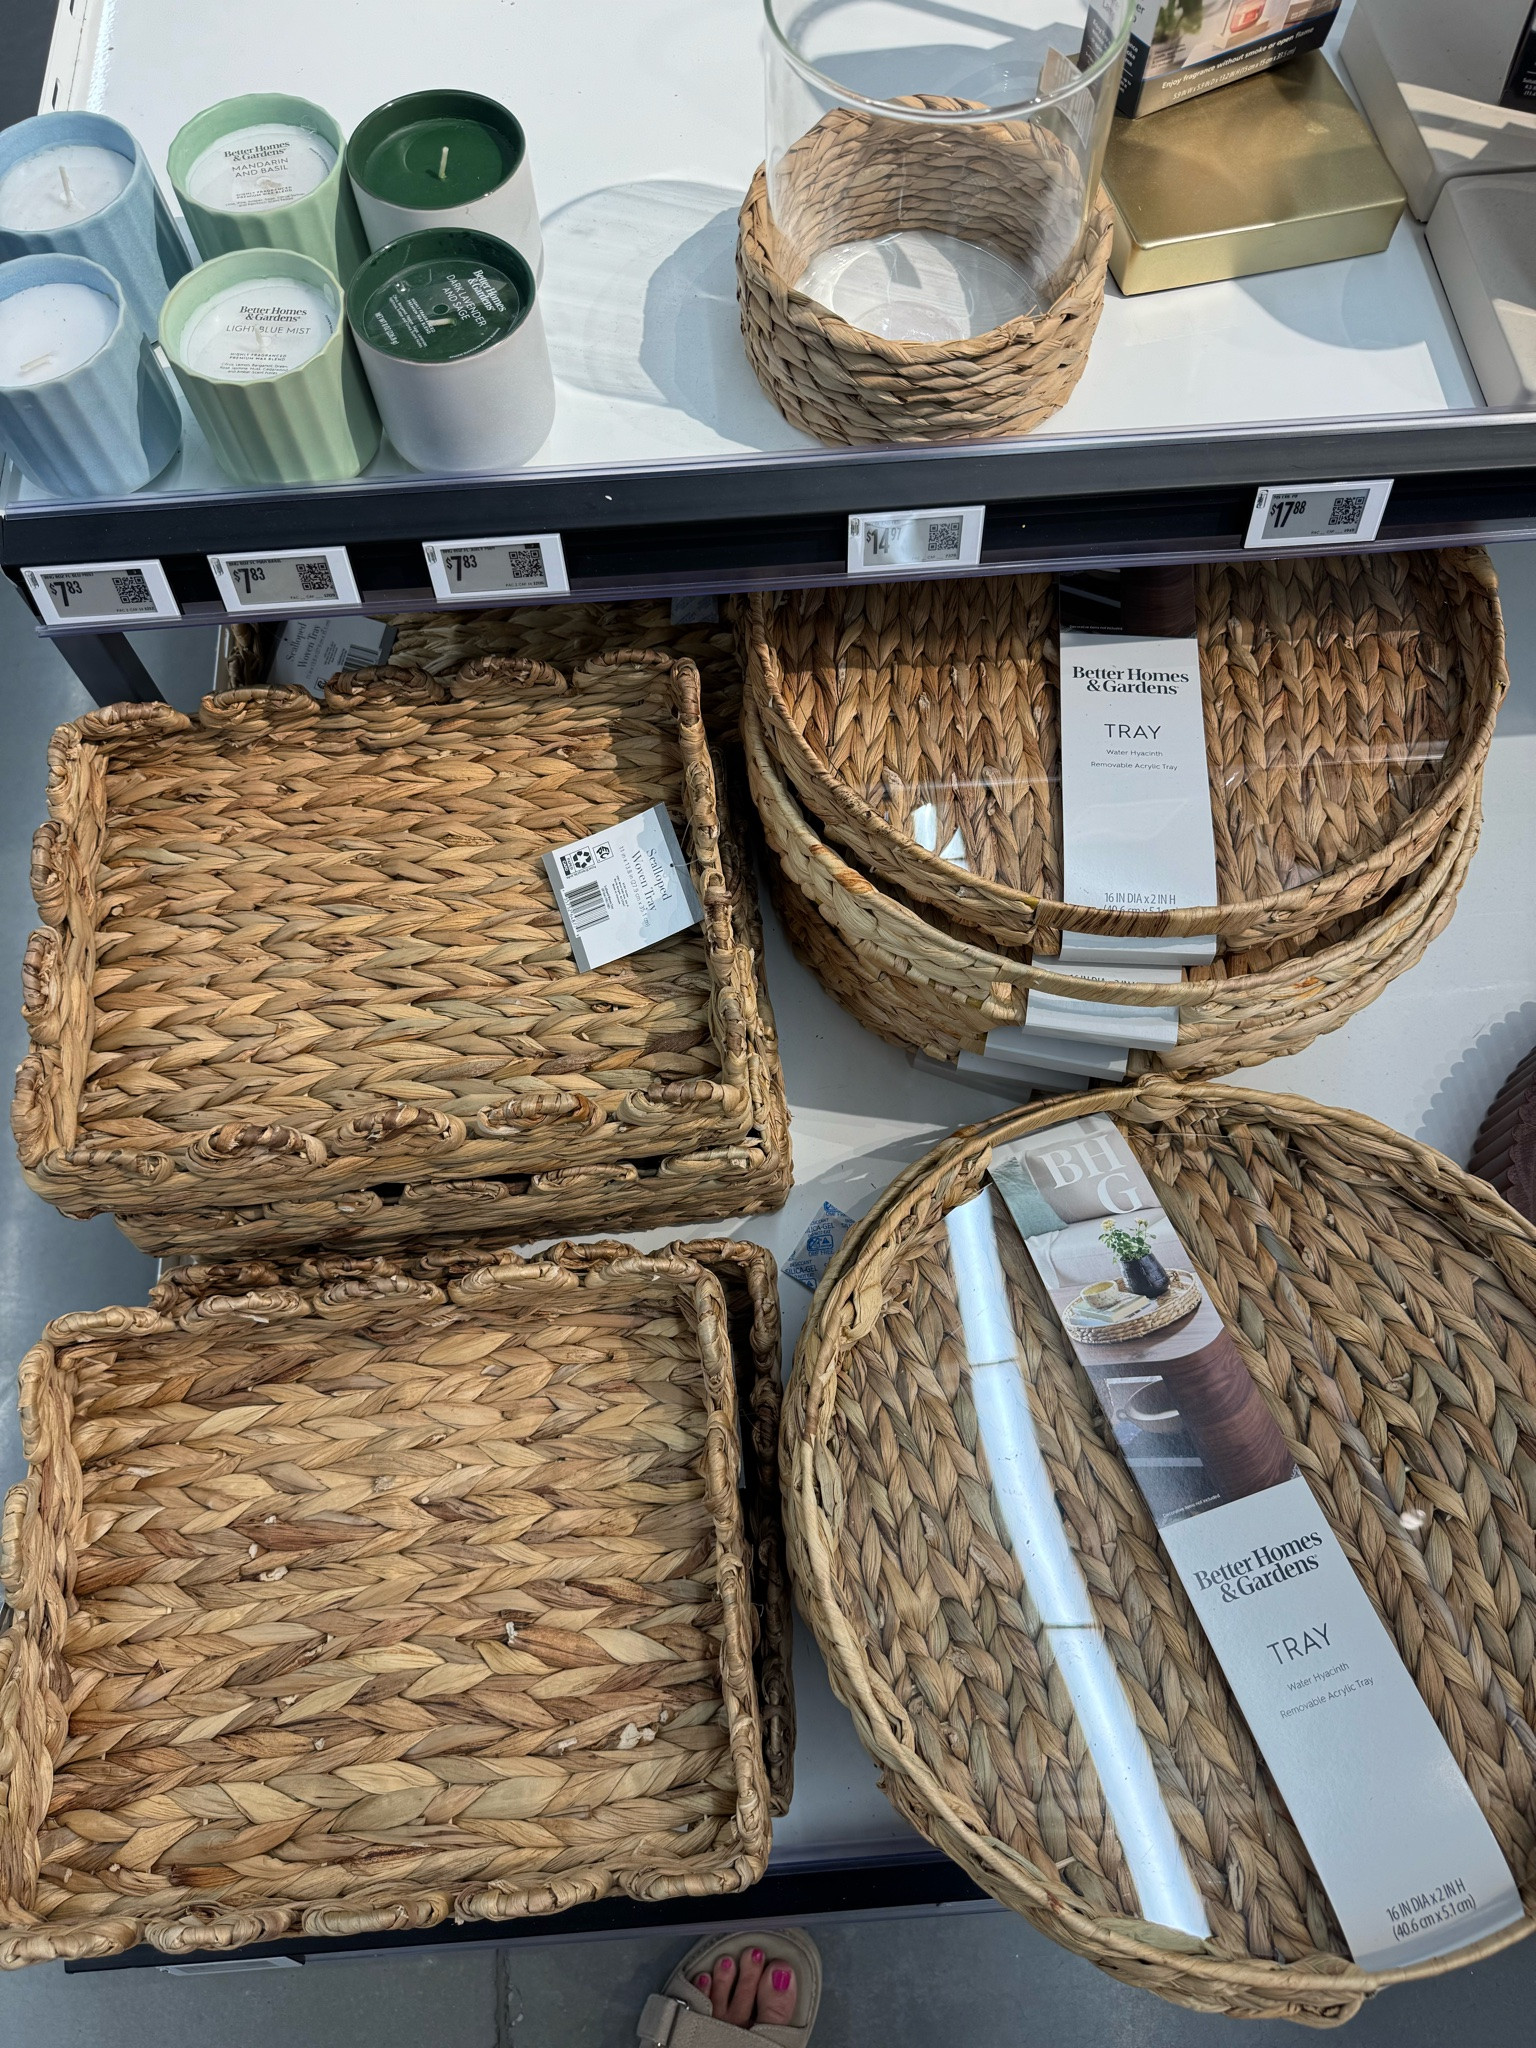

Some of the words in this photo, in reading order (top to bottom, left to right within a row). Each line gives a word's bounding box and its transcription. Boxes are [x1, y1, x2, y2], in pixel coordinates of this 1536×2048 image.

[1162, 77, 1182, 90] Enjoy
[1183, 66, 1215, 82] fragrance
[1217, 53, 1244, 69] without
[1244, 46, 1267, 59] smoke
[1276, 35, 1294, 47] open
[224, 146, 254, 158] Better
[255, 141, 290, 153] Homes
[241, 149, 285, 161] Gardens
[232, 158, 289, 172] MANDARIN
[235, 169, 258, 178] AND
[261, 165, 288, 175] BASIL
[442, 287, 458, 302] AND
[452, 301, 471, 321] SAGE
[446, 274, 465, 293] DARK
[458, 291, 487, 327] LAVENDER
[472, 282, 494, 311] Gardens
[473, 269, 491, 289] Better
[485, 287, 506, 312] Homes
[239, 306, 271, 315] Better
[271, 307, 307, 316] Homes
[254, 314, 298, 323] Gardens
[226, 325, 255, 333] LIGHT
[259, 326, 283, 334] BLUE
[286, 327, 311, 335] MIST
[286, 622, 307, 662] Scalloped
[297, 642, 314, 668] Woven
[307, 626, 321, 640] Tray
[1072, 666, 1125, 680] Better
[1127, 668, 1189, 683] Homes
[1086, 680, 1101, 692] &
[1102, 680, 1178, 695] Gardens
[1104, 723, 1162, 740] TRAY
[1091, 761, 1133, 770] Removable
[1134, 762, 1161, 772] Acrylic
[1162, 763, 1178, 772] Tray
[1106, 748, 1129, 757] Water
[1130, 749, 1164, 759] Hyacinth
[631, 850, 649, 888] Woven
[644, 887, 657, 912] Tray
[647, 848, 673, 902] Scalloped
[1104, 892, 1114, 903] 16
[1116, 893, 1125, 903] IN
[1127, 893, 1143, 904] DIA
[1144, 896, 1150, 904] x
[1151, 894, 1156, 905] 2
[1158, 894, 1168, 905] IN
[1169, 894, 1176, 905] H
[784, 1265, 817, 1275] SILICA-GEL
[1203, 1493, 1221, 1504] included
[1193, 1556, 1254, 1591] Better
[1251, 1530, 1323, 1568] Homes
[1220, 1583, 1241, 1604] &
[1236, 1554, 1320, 1597] Gardens
[1267, 1622, 1332, 1665] TRAY
[1287, 1676, 1313, 1692] Water
[1313, 1662, 1350, 1683] Hyacinth
[1279, 1694, 1327, 1719] Removable
[1327, 1684, 1358, 1702] Acrylic
[1356, 1676, 1375, 1690] Tray
[1386, 1905, 1400, 1923] 16
[1399, 1899, 1412, 1917] IN
[1411, 1893, 1430, 1912] DIA
[1430, 1892, 1436, 1904] x
[1435, 1887, 1446, 1902] 2
[1442, 1881, 1457, 1900] IN
[1455, 1878, 1467, 1893] H
[1393, 1919, 1419, 1942] (40.6
[1420, 1914, 1436, 1929] cm
[1435, 1911, 1442, 1922] x
[1442, 1901, 1458, 1921] 5.1
[1458, 1893, 1477, 1912] cm)
